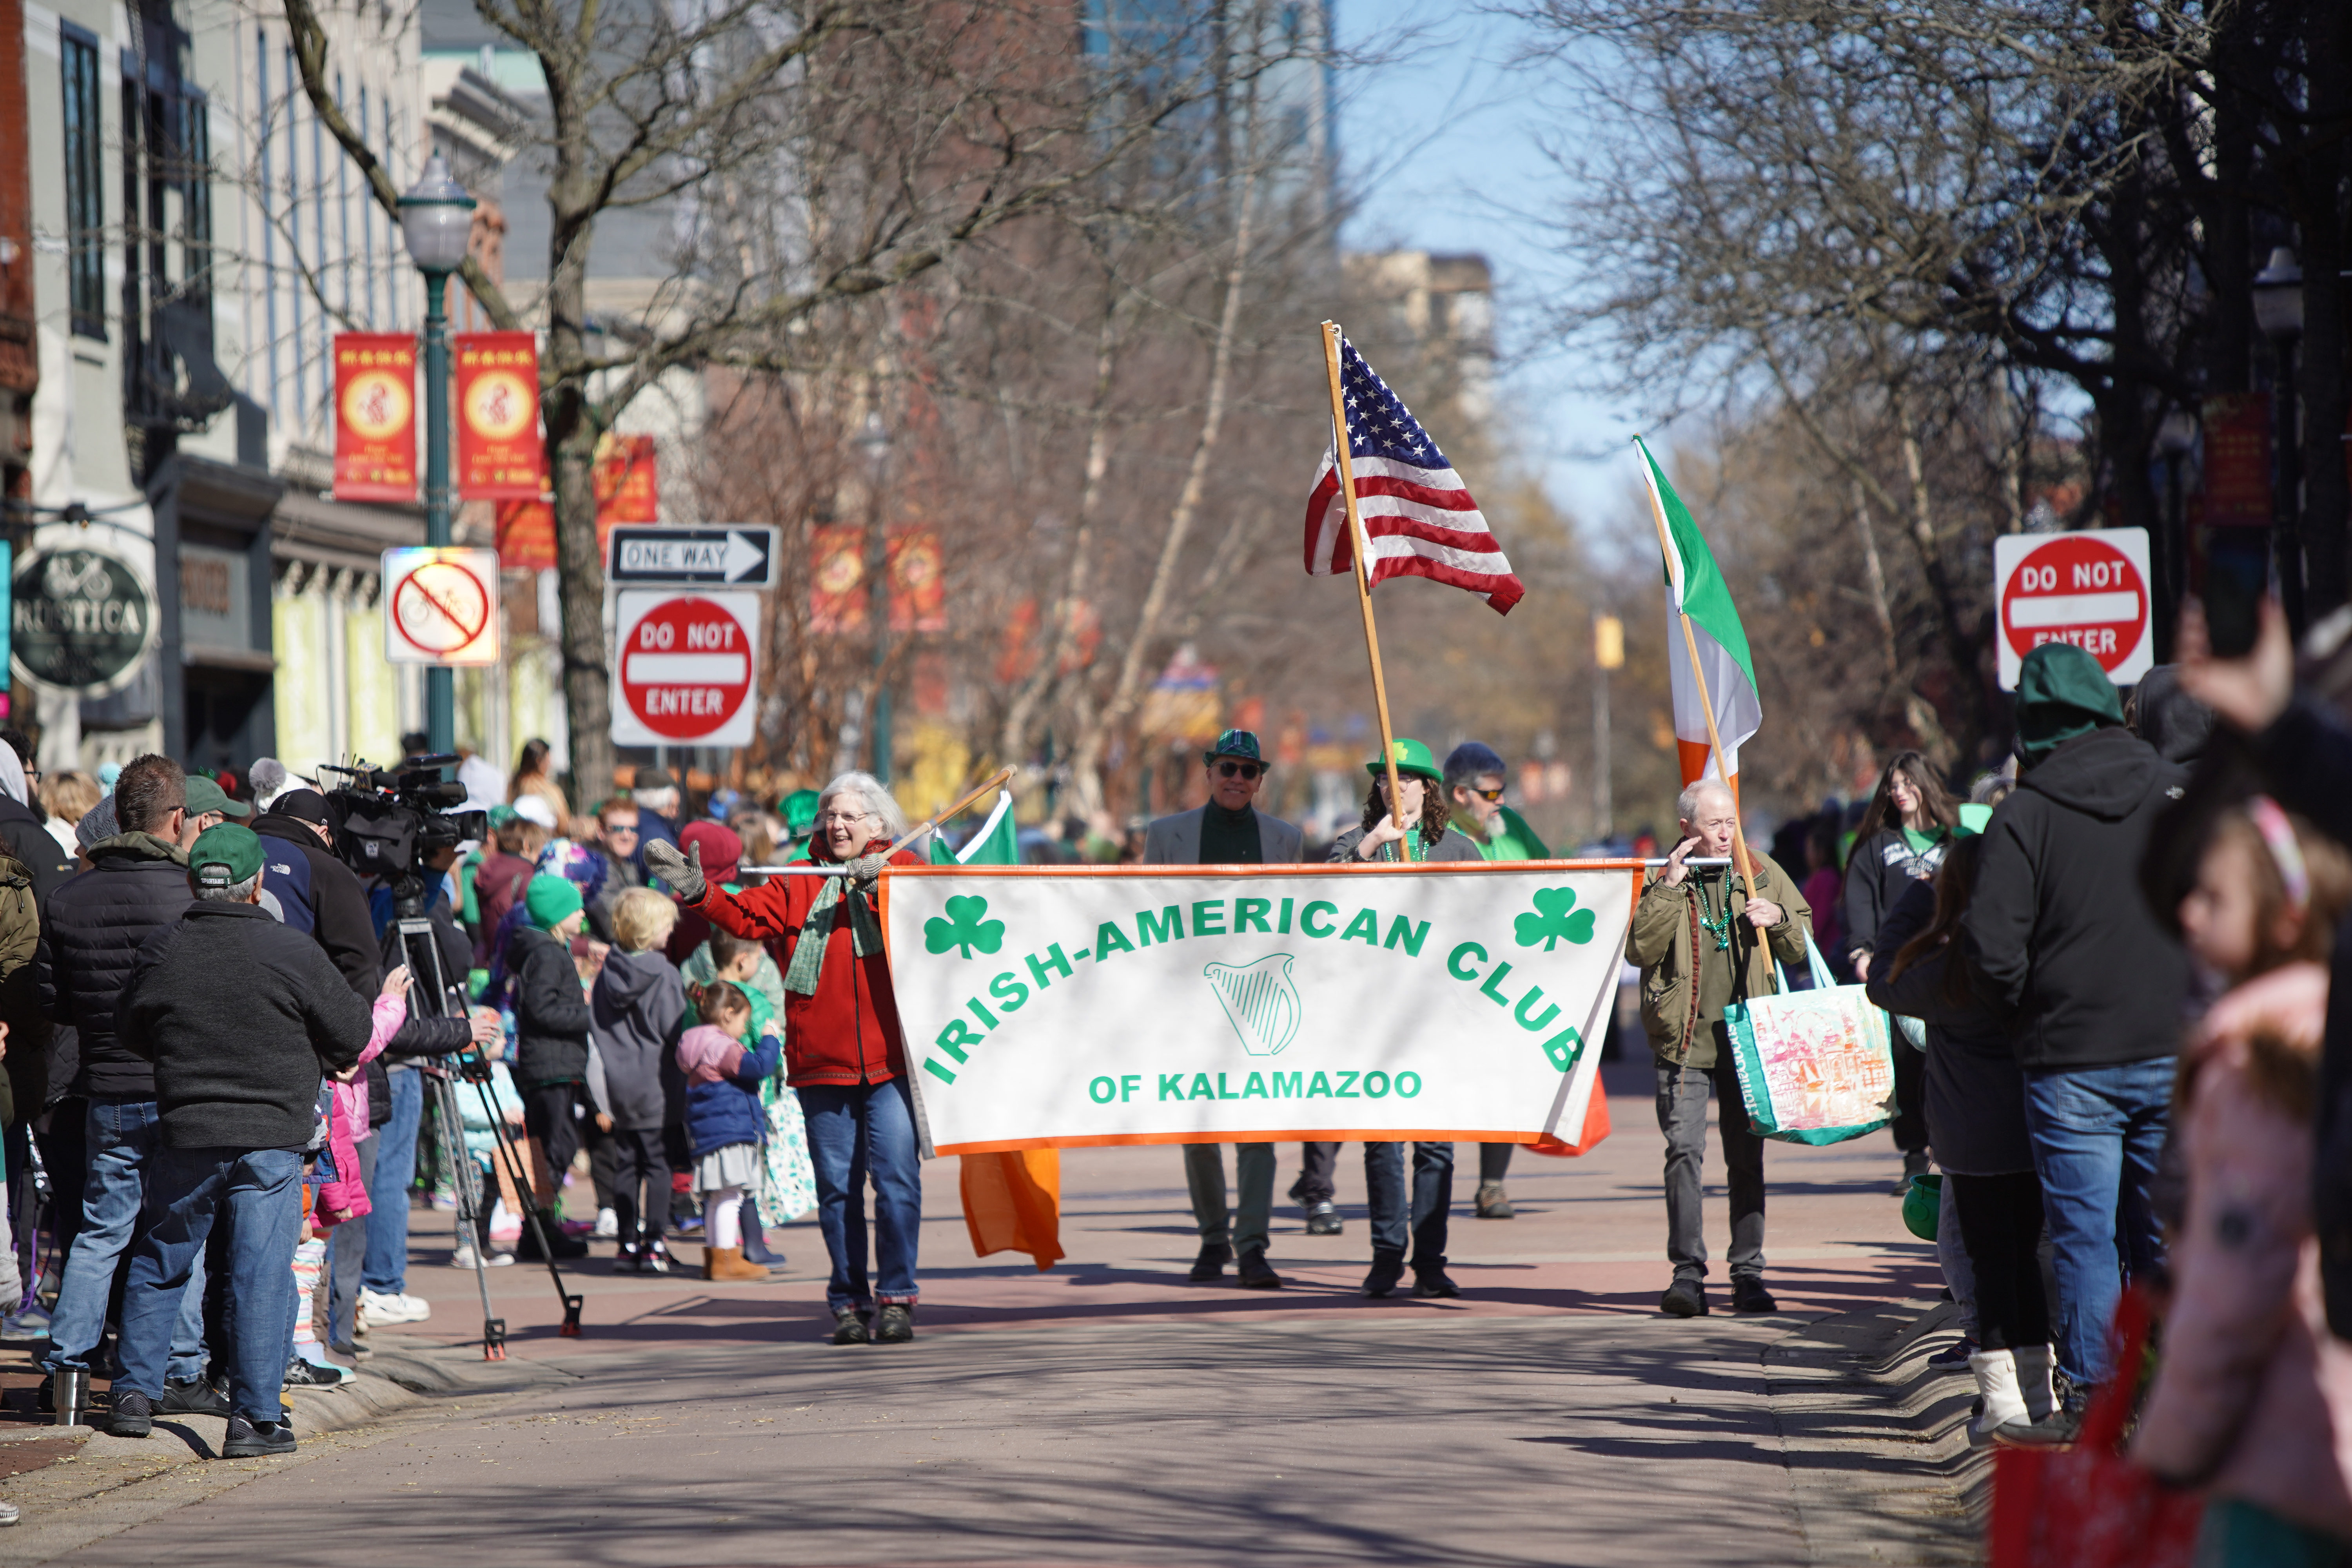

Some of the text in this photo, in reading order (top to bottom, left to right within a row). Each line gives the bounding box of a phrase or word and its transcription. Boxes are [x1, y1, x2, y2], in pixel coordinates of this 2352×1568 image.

[628, 543, 728, 567] ONE WAY
[2022, 560, 2125, 592] DO NOT
[13, 598, 140, 635] RUSTICA
[640, 621, 736, 650] DO NOT
[646, 688, 725, 716] ENTER
[924, 895, 1584, 1084] IRISH-AMERICAN CLUB
[1089, 1071, 1421, 1104] OF KALAMAZOO
